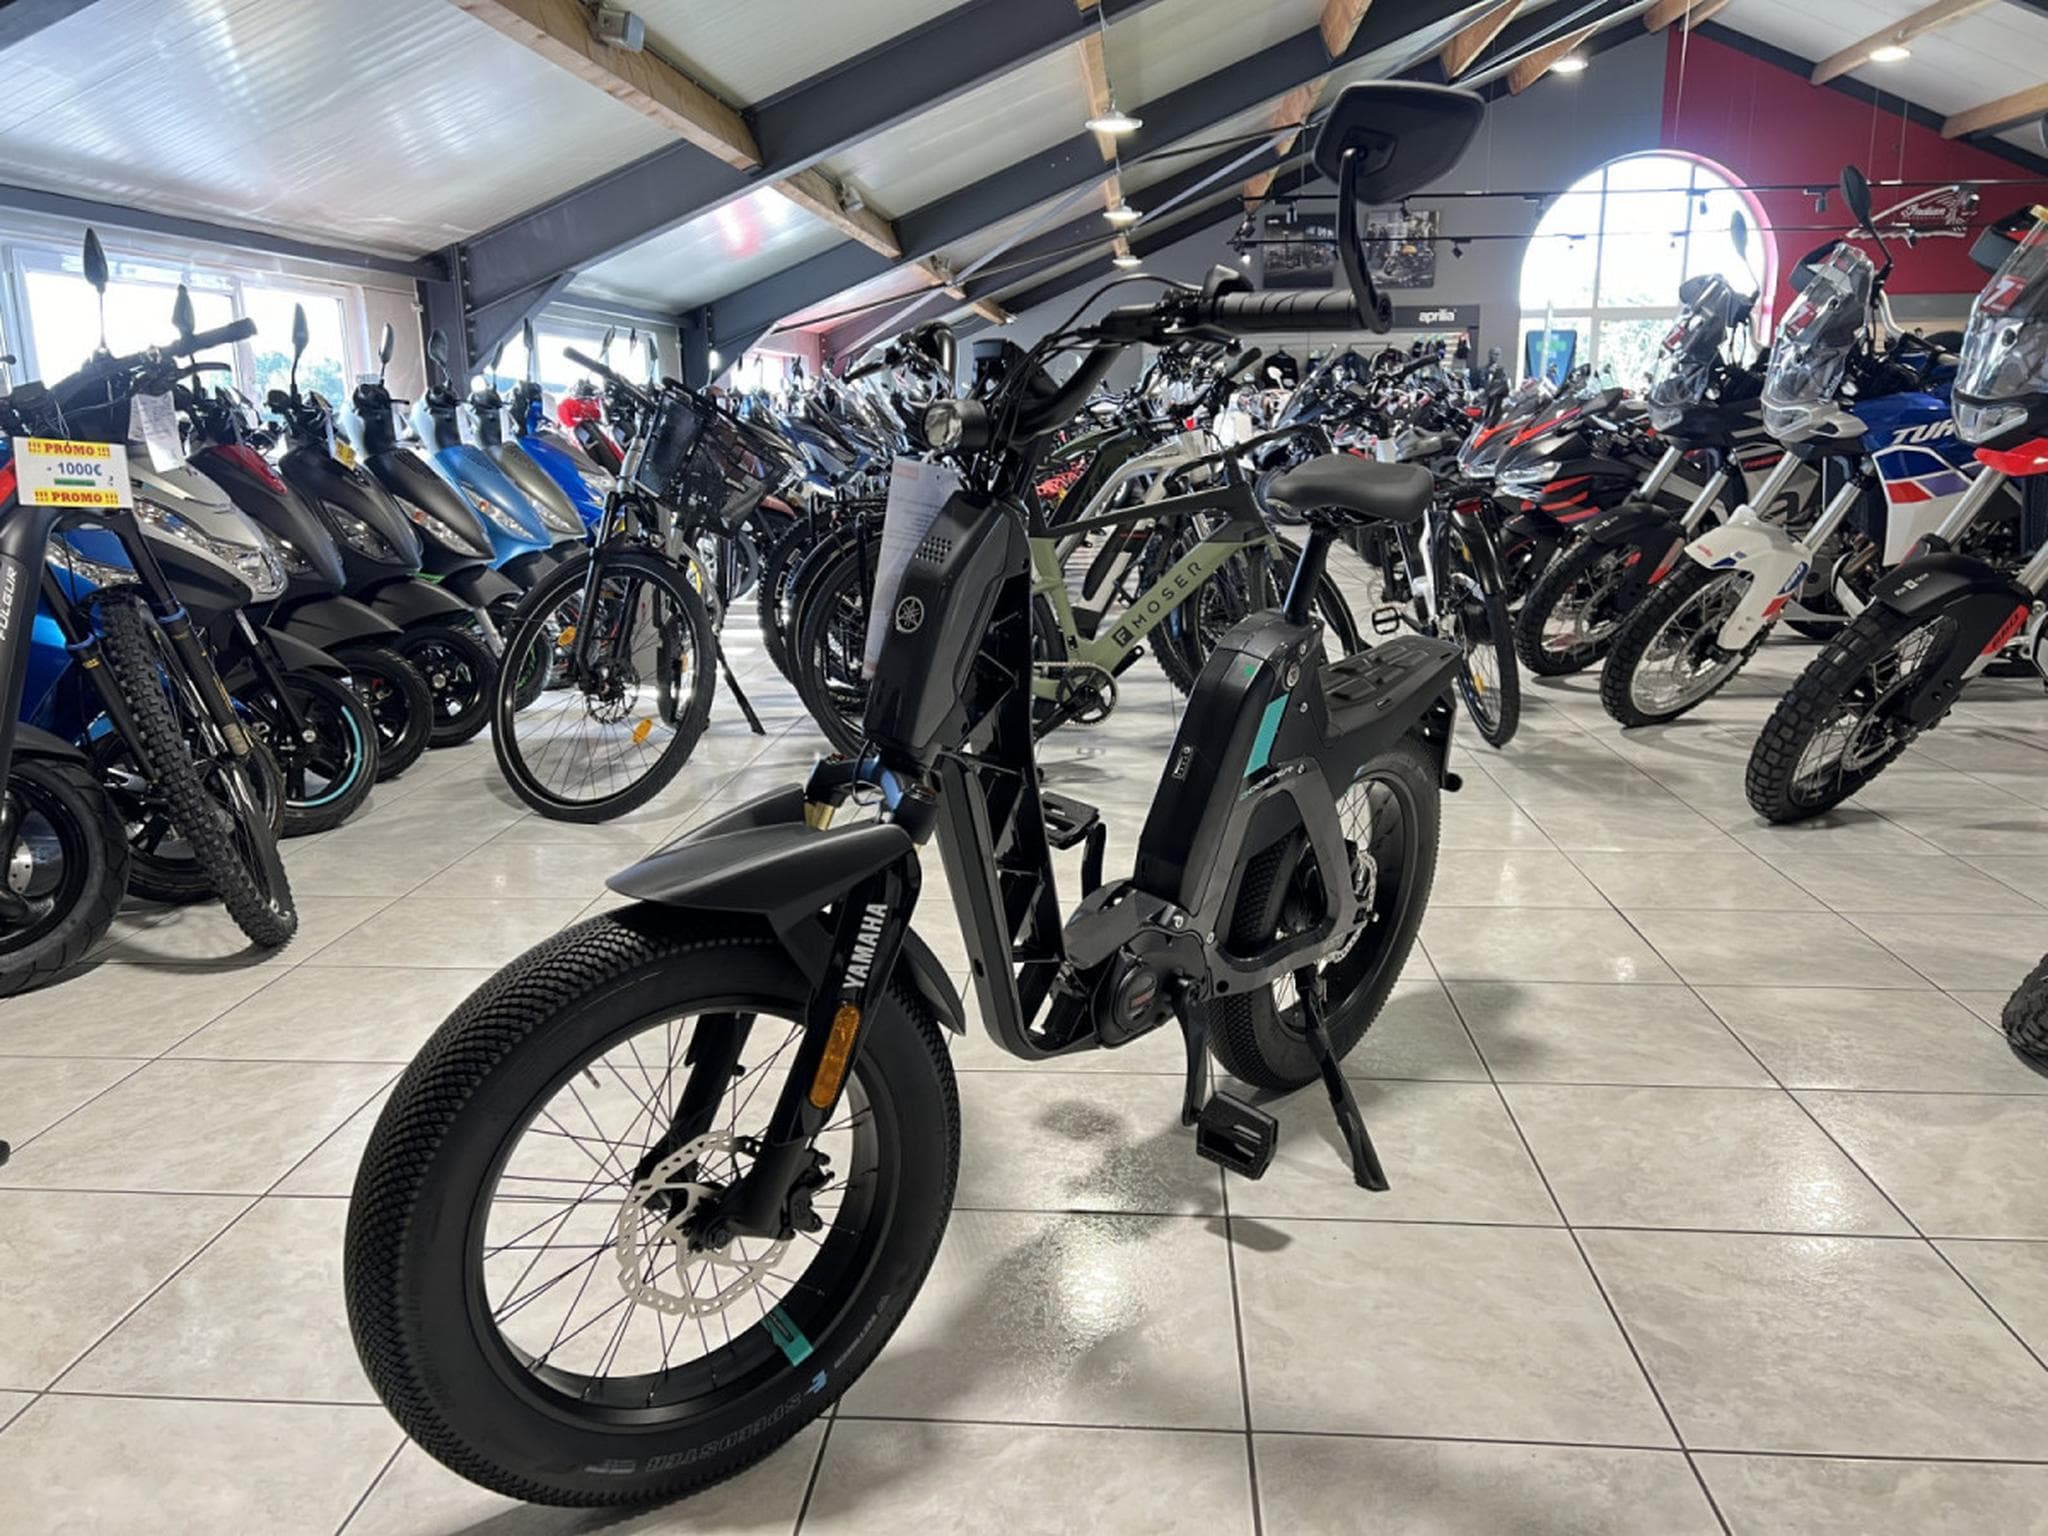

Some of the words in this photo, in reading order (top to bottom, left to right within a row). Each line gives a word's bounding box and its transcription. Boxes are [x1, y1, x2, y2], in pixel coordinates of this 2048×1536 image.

[44, 442, 95, 456] PROMO
[58, 462, 102, 476] 1000€
[51, 492, 102, 503] PROMO
[1132, 561, 1202, 629] MOSER
[842, 903, 888, 989] YAMAHA
